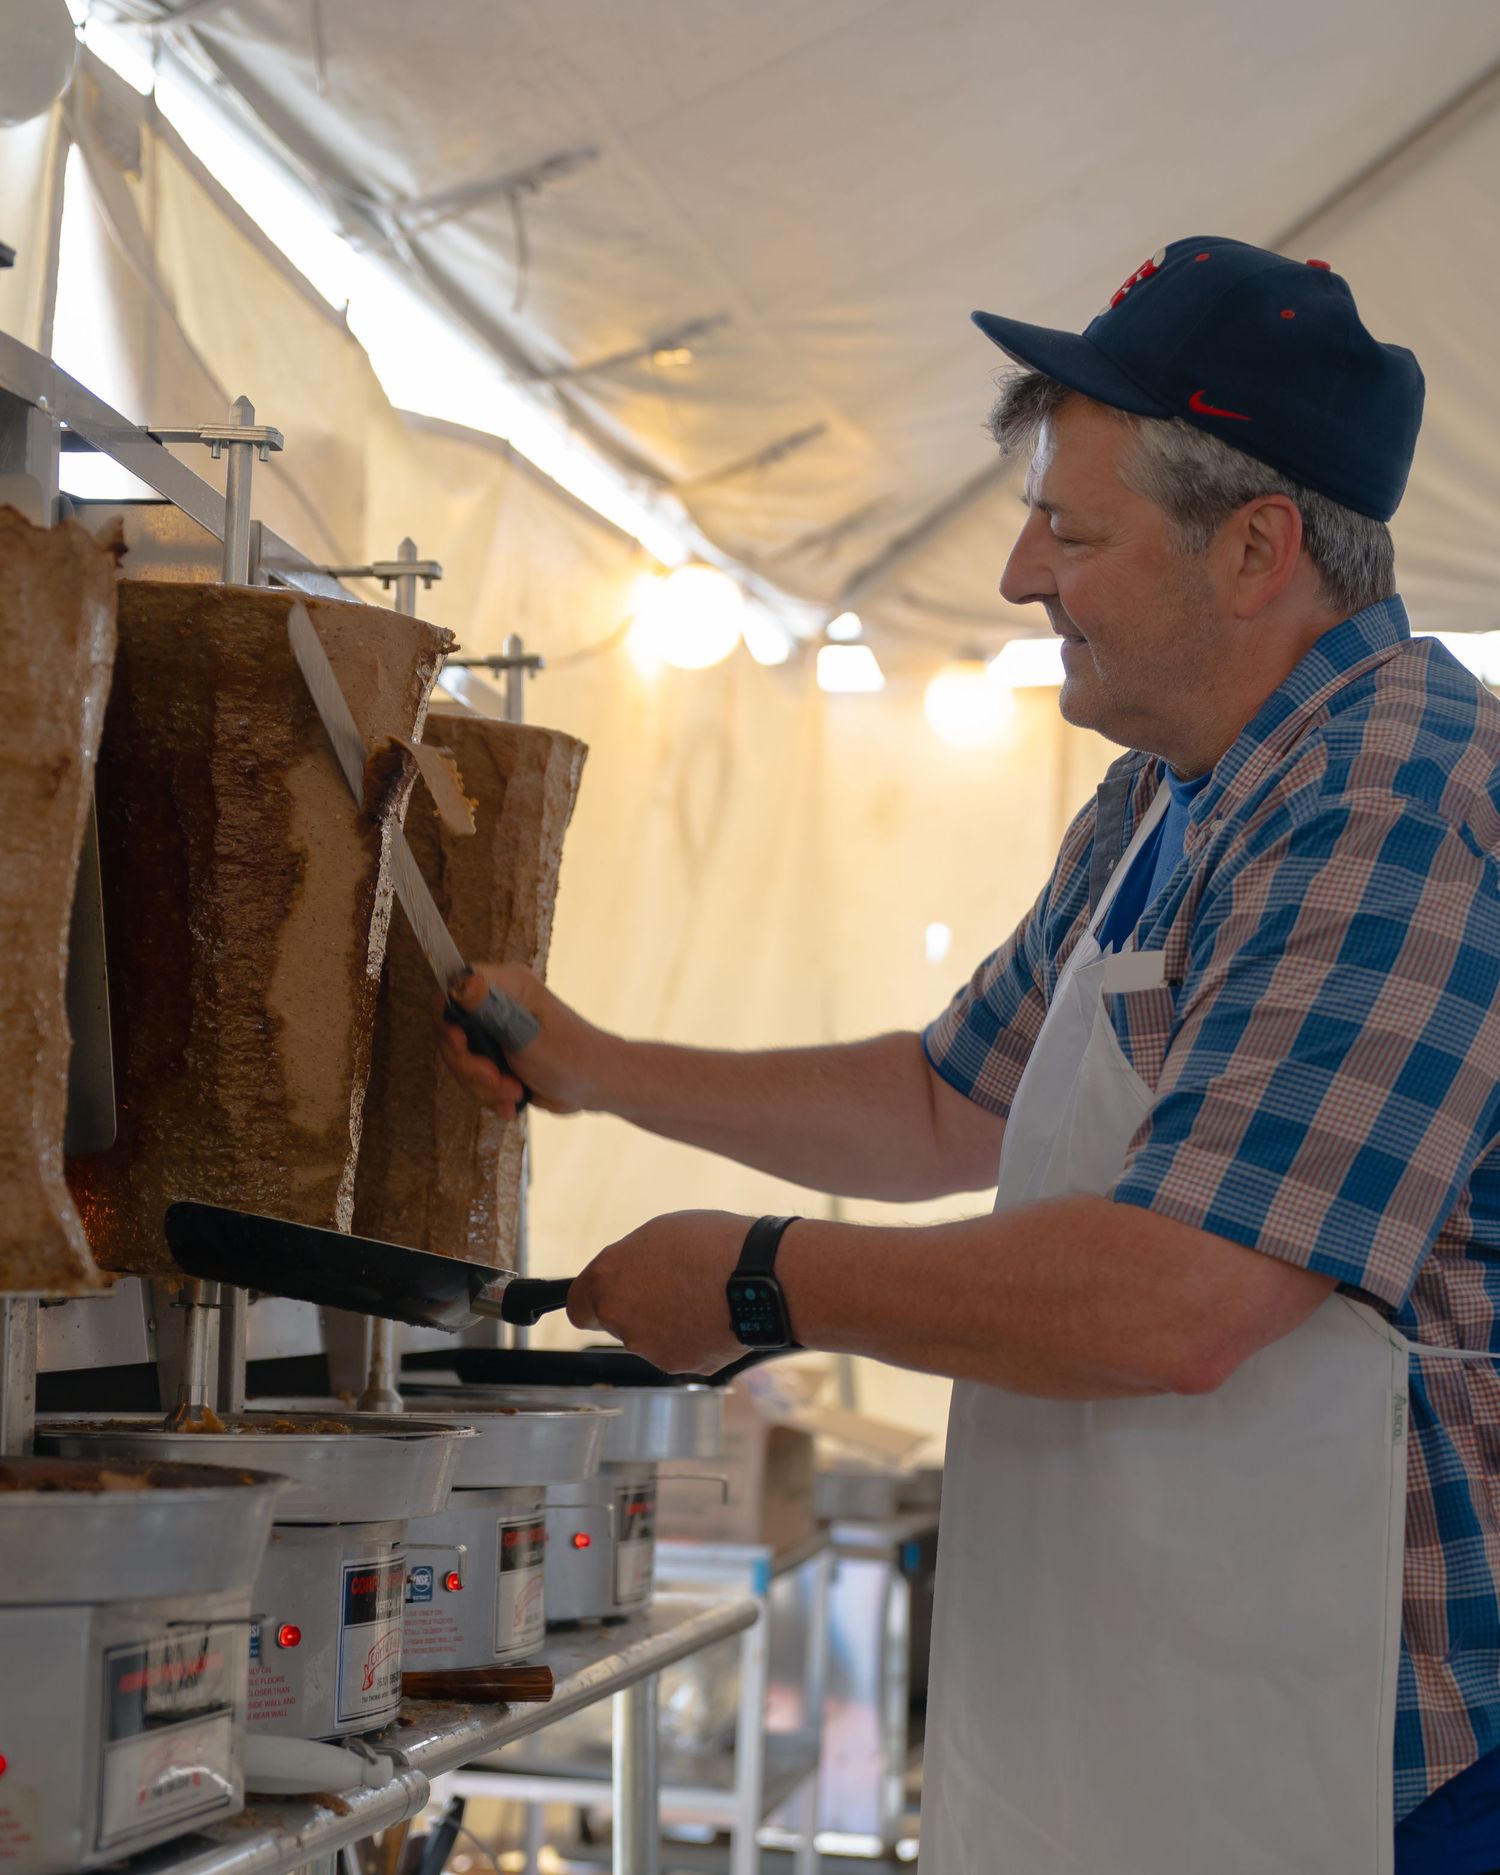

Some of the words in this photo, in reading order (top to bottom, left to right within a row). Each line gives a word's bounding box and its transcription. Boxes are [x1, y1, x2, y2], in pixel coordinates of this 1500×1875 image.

[416, 1575, 429, 1586] NSF
[273, 1686, 290, 1696] THAN
[264, 1699, 281, 1708] WALL
[283, 1696, 296, 1706] AND
[271, 1708, 289, 1718] WALL
